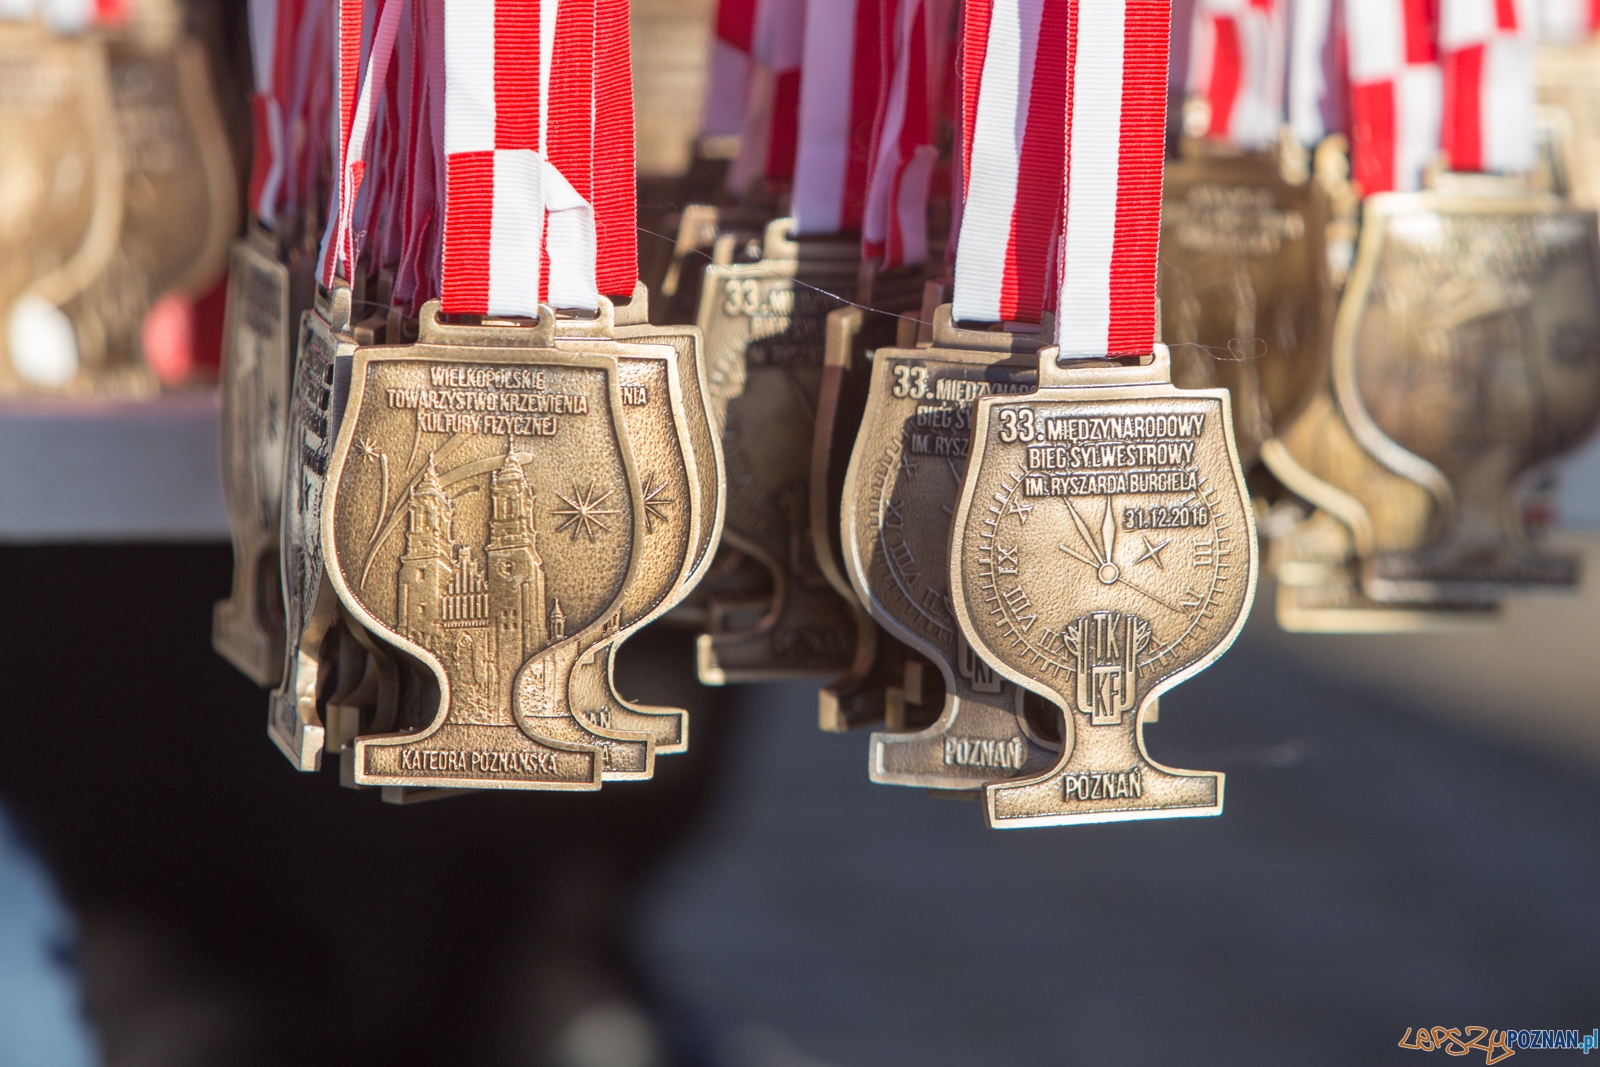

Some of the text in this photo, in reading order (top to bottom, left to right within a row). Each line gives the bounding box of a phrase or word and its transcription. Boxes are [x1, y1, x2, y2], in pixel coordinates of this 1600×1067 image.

[431, 366, 546, 390] WIELKOPOLSKIE
[892, 364, 934, 399] 33.
[386, 388, 589, 414] TOWARZYSTWO KRZEWIENIA
[417, 412, 558, 436] KULTURY FIZYCZNEJ
[916, 405, 952, 428] BIEG
[1000, 409, 1045, 442] 33.
[1046, 414, 1205, 444] MIĘDZYNARODOWY
[1028, 442, 1195, 470] BIEG SYLWESTROWY
[1024, 471, 1198, 497] IM. RYSZARDA BURGIELA
[1122, 506, 1210, 530] 31.12.2016
[401, 748, 560, 775] KATEDRA POZNAŃSKA
[944, 736, 1022, 770] POZNAŃ
[1063, 769, 1144, 801] POZNAŃ
